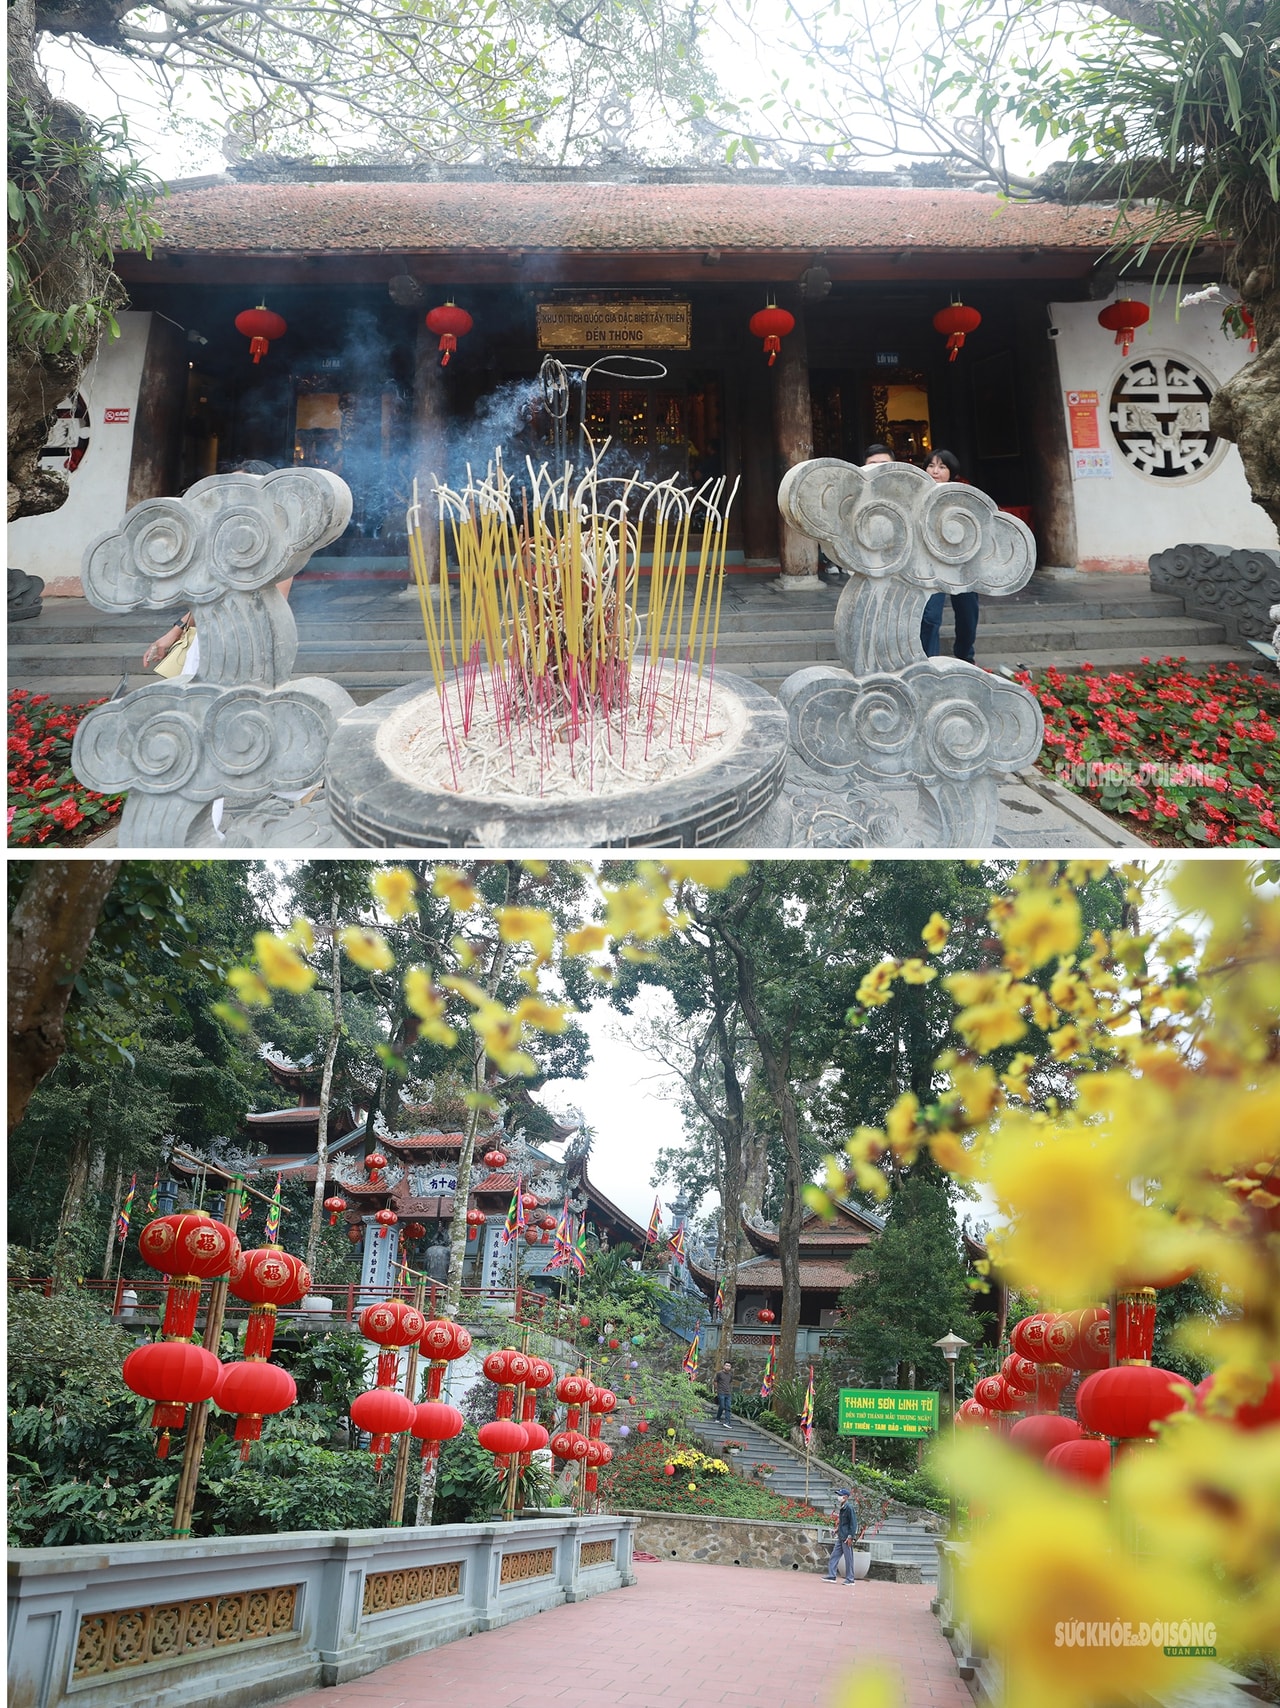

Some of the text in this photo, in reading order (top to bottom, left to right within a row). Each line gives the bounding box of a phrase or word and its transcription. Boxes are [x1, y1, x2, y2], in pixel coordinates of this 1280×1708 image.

[584, 310, 603, 323] QUỐC
[605, 314, 617, 323] GIA
[844, 1396, 934, 1411] THANH SƠN LINH TỪ
[874, 1423, 886, 1431] TAM
